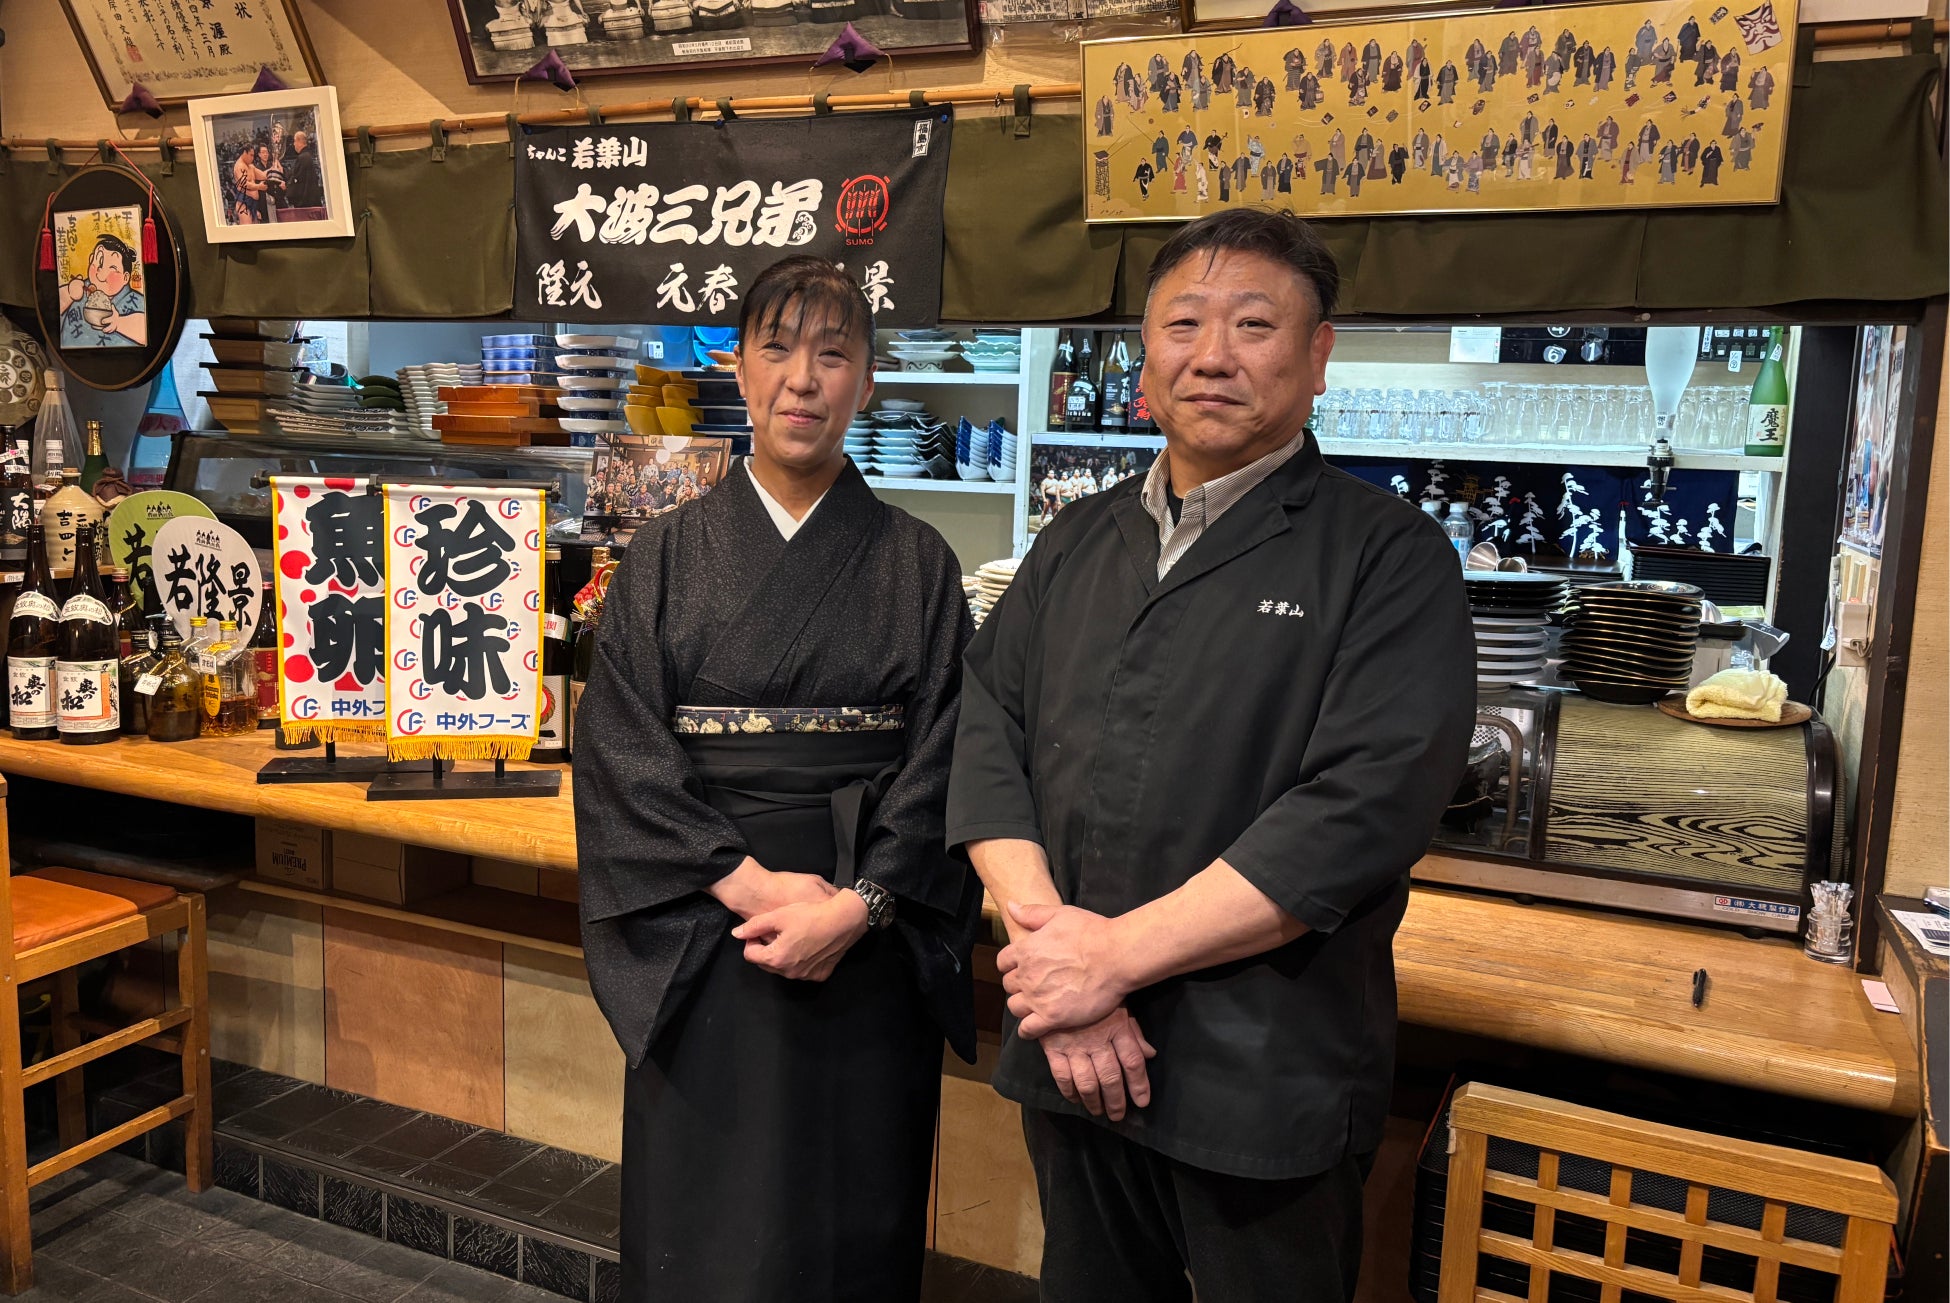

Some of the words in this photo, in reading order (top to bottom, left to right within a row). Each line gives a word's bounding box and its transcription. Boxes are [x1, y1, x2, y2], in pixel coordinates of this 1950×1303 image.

[234, 2, 253, 19] 状
[527, 144, 567, 163] ちゃんこ
[571, 136, 648, 169] 若葉山
[550, 178, 823, 248] 大波三兄弟
[845, 238, 874, 246] SUMO
[536, 259, 603, 310] 隆元
[656, 261, 739, 315] 元春
[1759, 408, 1779, 441] 魔王
[165, 544, 254, 631] 若隆景
[414, 499, 515, 700] 珍味
[1257, 599, 1304, 617] 若葉山
[11, 674, 46, 708] 奥の松
[61, 678, 98, 711] 奥の松
[436, 712, 531, 731] 中外フーズ
